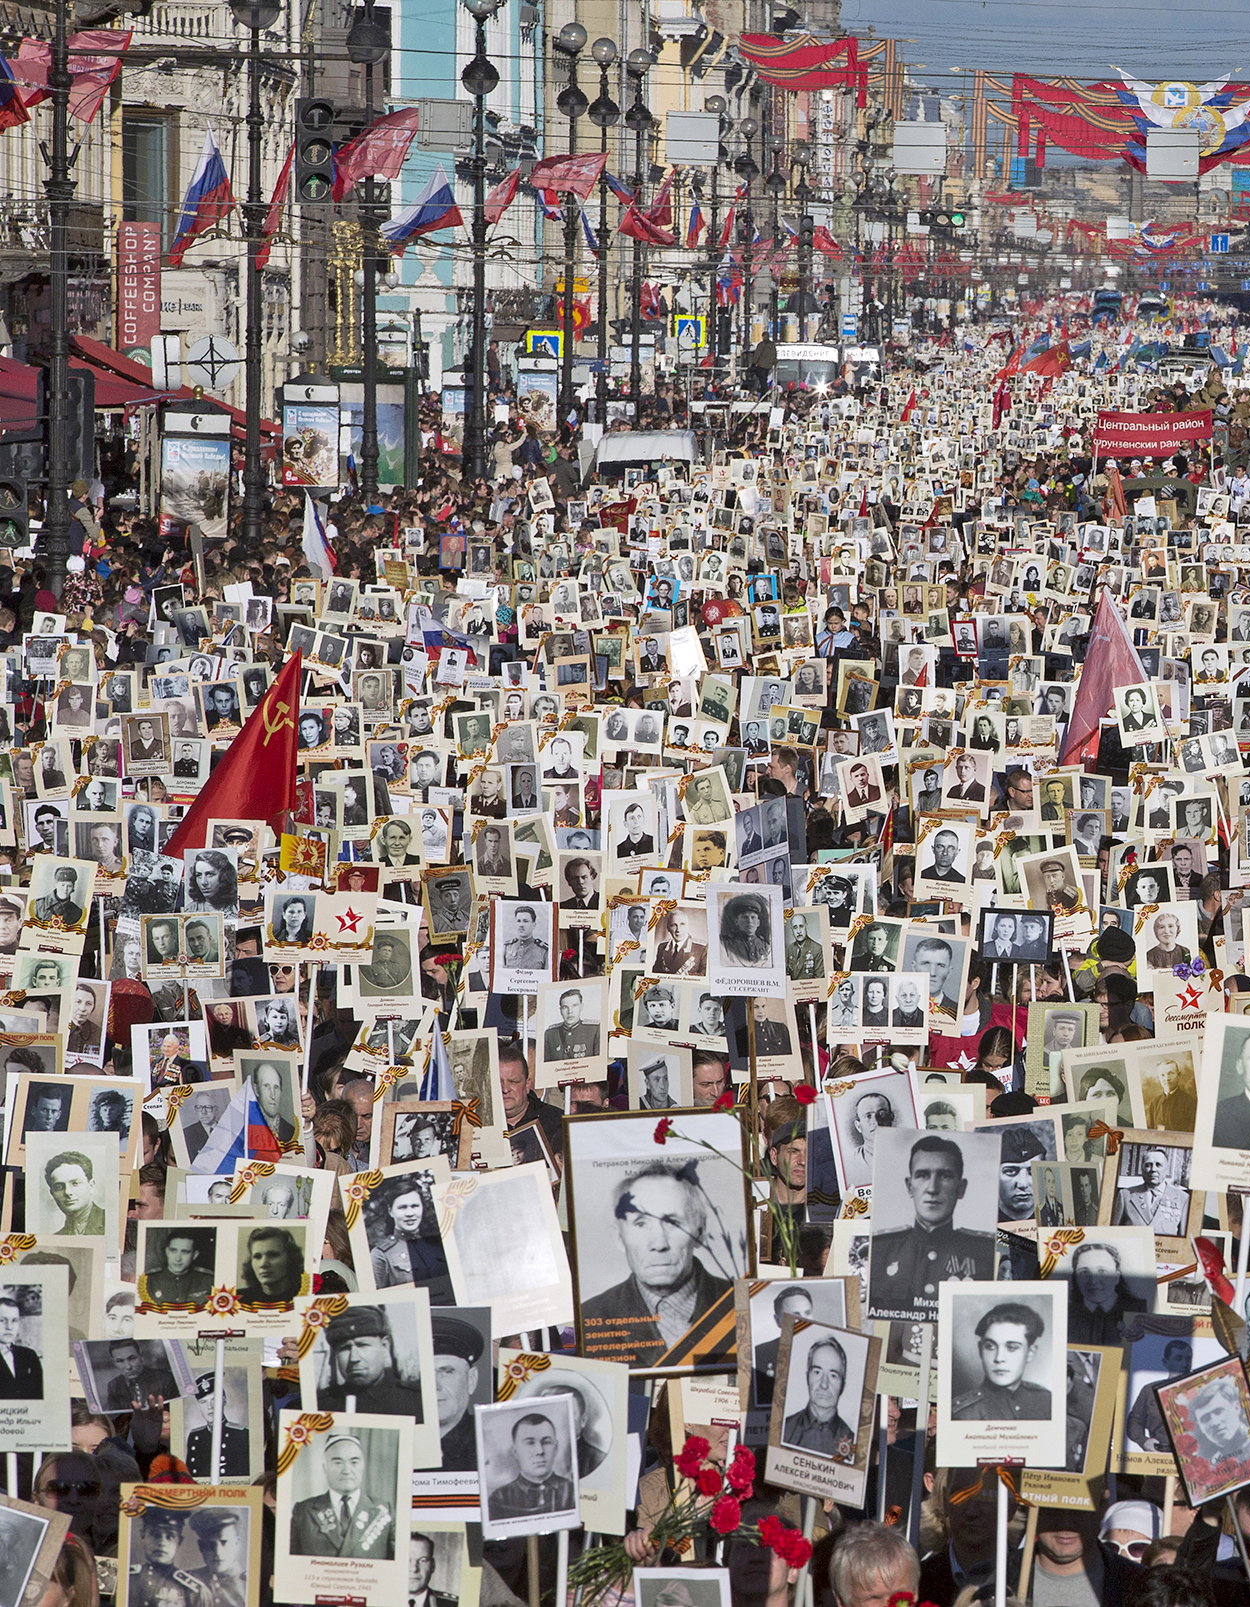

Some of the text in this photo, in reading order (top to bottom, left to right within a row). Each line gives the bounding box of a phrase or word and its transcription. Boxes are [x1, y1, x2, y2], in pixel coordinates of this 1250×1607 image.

[143, 228, 156, 313] COMPANY
[124, 226, 137, 345] COFFEESHOP
[1098, 418, 1205, 433] Центральный район
[715, 977, 780, 987] ФЁДОРОВЦЕВ В.М.
[728, 985, 770, 993] СТ.СЕРЖАНТ
[1177, 1020, 1206, 1032] ПОЛК
[630, 1158, 664, 1167] Николай
[1219, 1159, 1246, 1168] Николай
[584, 1314, 661, 1327] 303 отдельный
[585, 1329, 631, 1339] зенитно-
[585, 1339, 665, 1352] артелерийский
[880, 1366, 912, 1377] Поцелуев
[16, 1417, 42, 1425] Ильич
[0, 1427, 25, 1436] довой
[1116, 1454, 1141, 1464] Немов
[793, 1456, 836, 1476] СЕНЬКИН
[432, 1478, 479, 1487] Тимофееви
[774, 1464, 855, 1493] АЛЕКСЕЙ ИВАНОВИЧ
[1023, 1472, 1081, 1484] Пётр Иванович
[1024, 1481, 1052, 1490] Рядовой
[218, 1488, 247, 1499] ПОЛК
[1060, 1494, 1091, 1506] ПОЛК
[349, 1560, 374, 1569] Рузали
